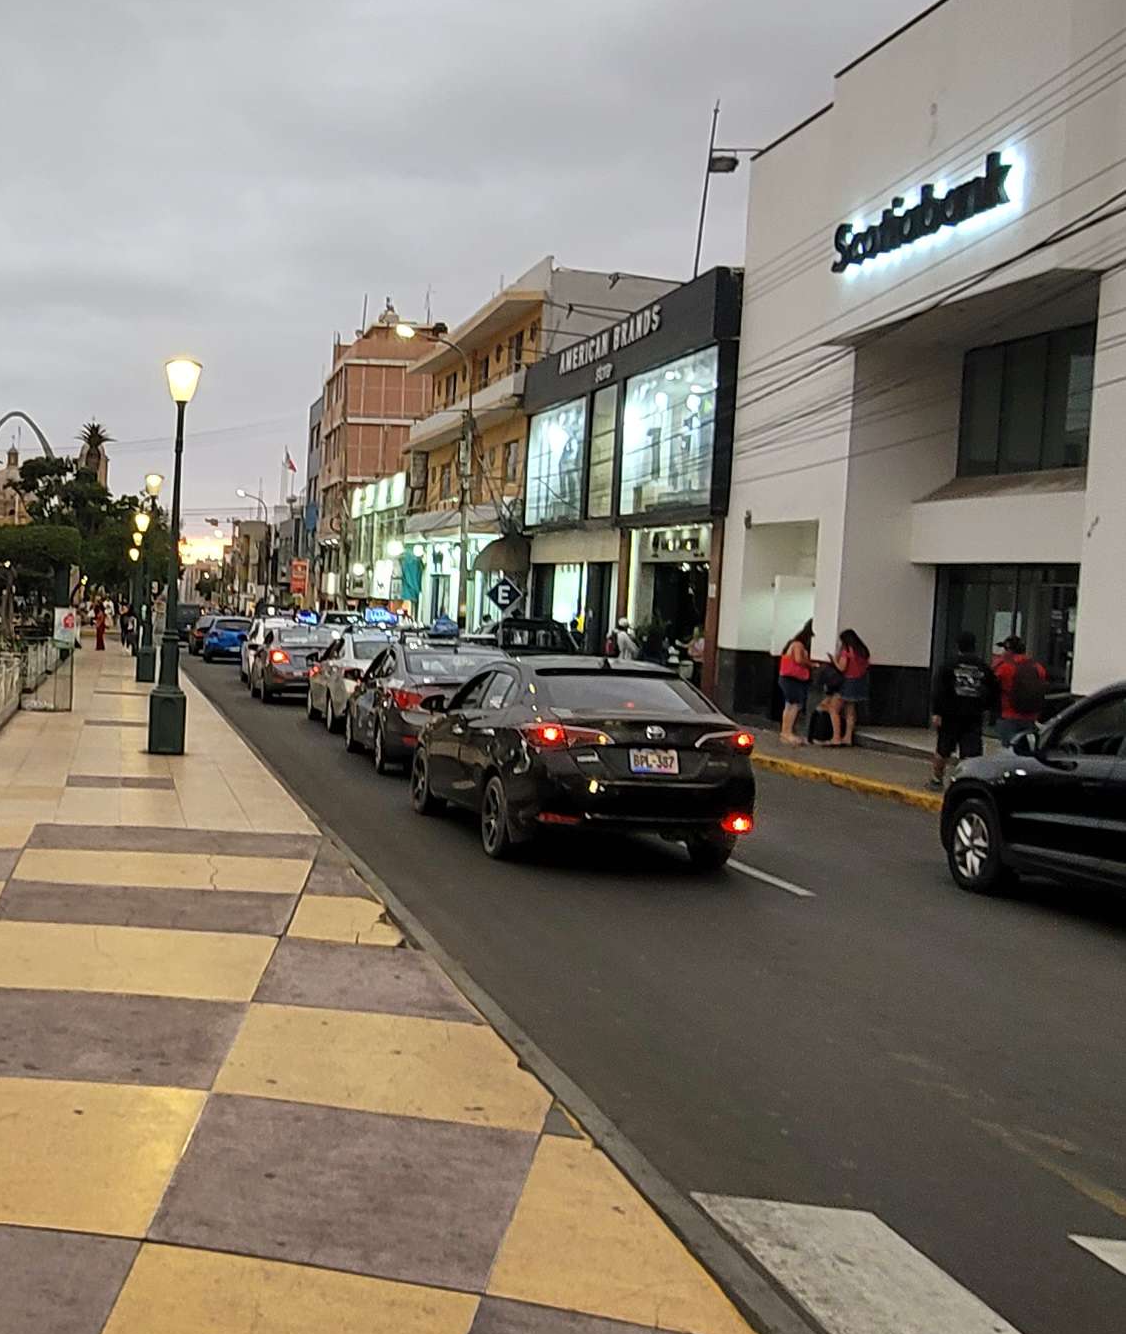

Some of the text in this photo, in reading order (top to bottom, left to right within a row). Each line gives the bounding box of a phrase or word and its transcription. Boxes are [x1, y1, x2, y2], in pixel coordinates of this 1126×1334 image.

[831, 150, 1012, 273] Scotiabank
[558, 304, 661, 376] AMERICAN BRANDS
[497, 585, 511, 604] E
